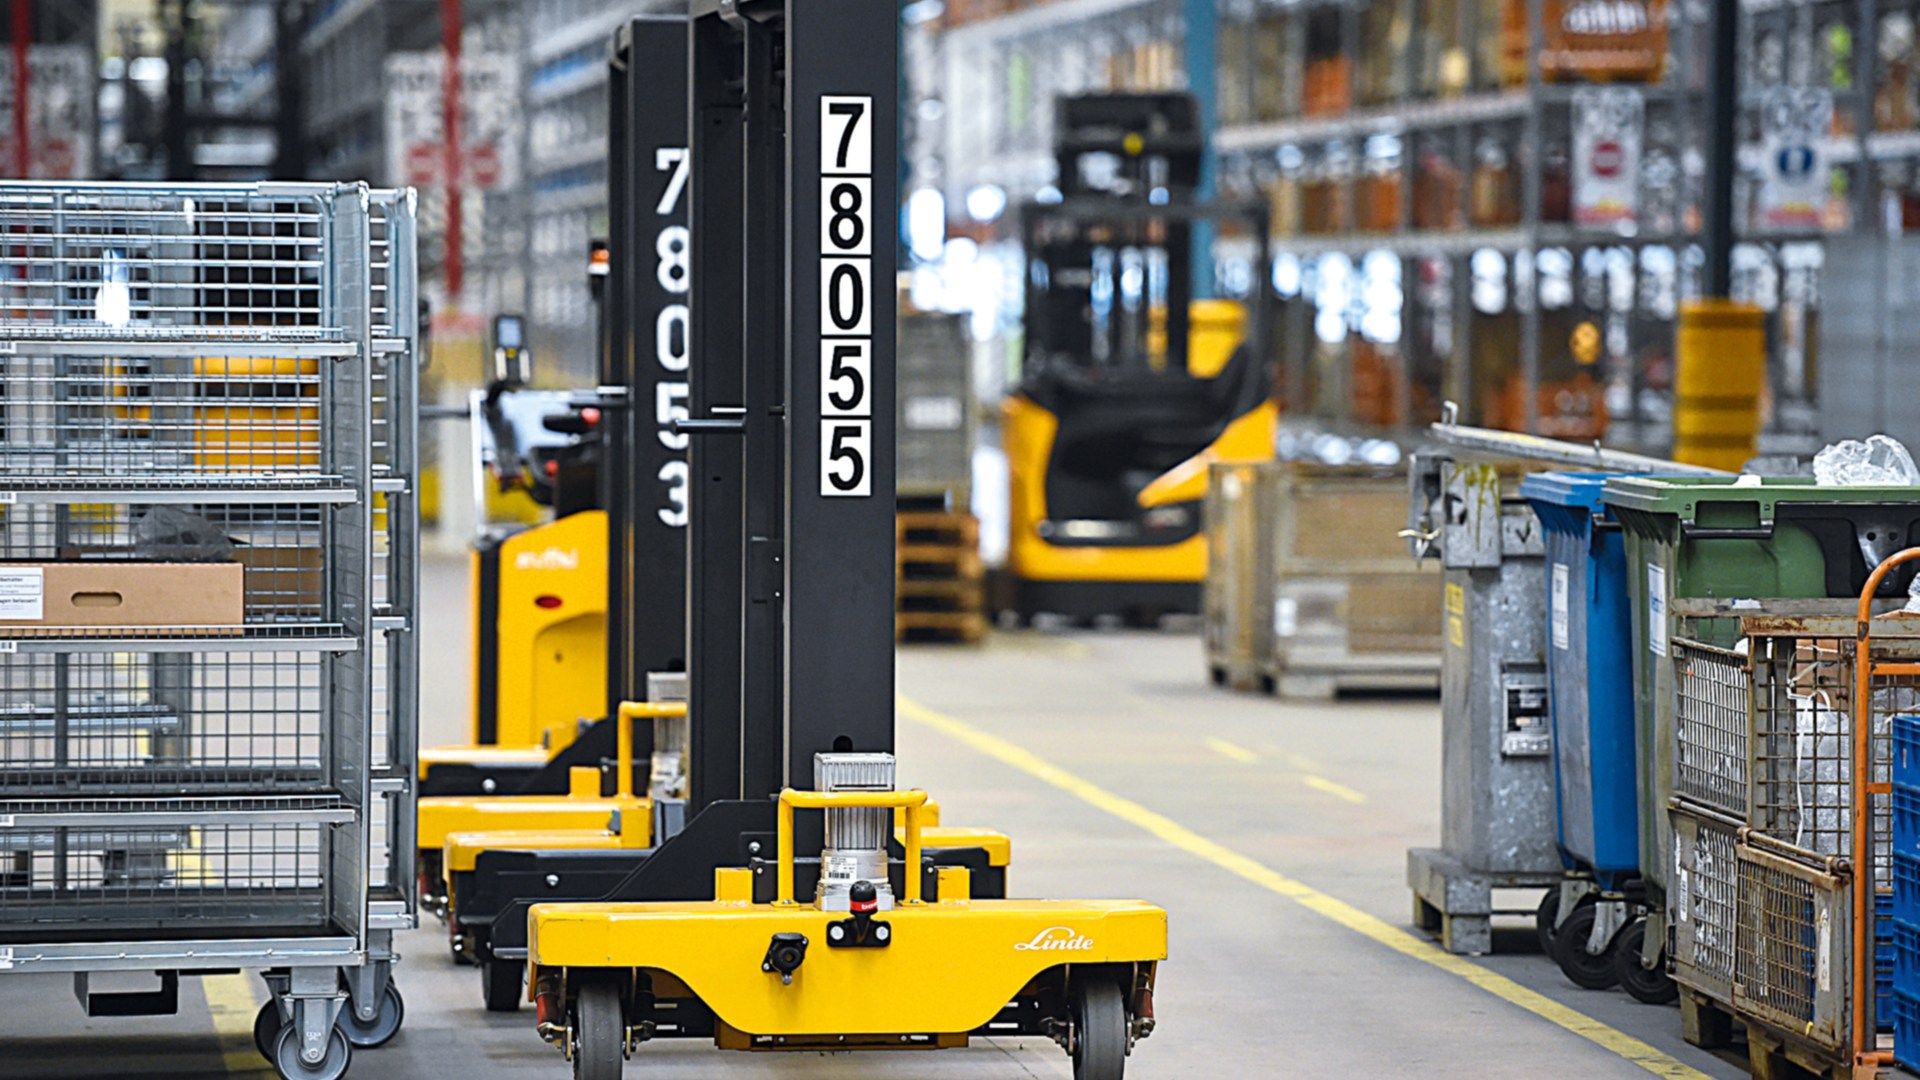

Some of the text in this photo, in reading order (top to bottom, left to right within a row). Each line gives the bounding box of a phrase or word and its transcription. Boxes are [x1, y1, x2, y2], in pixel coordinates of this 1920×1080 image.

[656, 148, 690, 527] 78053
[829, 103, 864, 490] 78055
[1014, 926, 1094, 950] Linde
